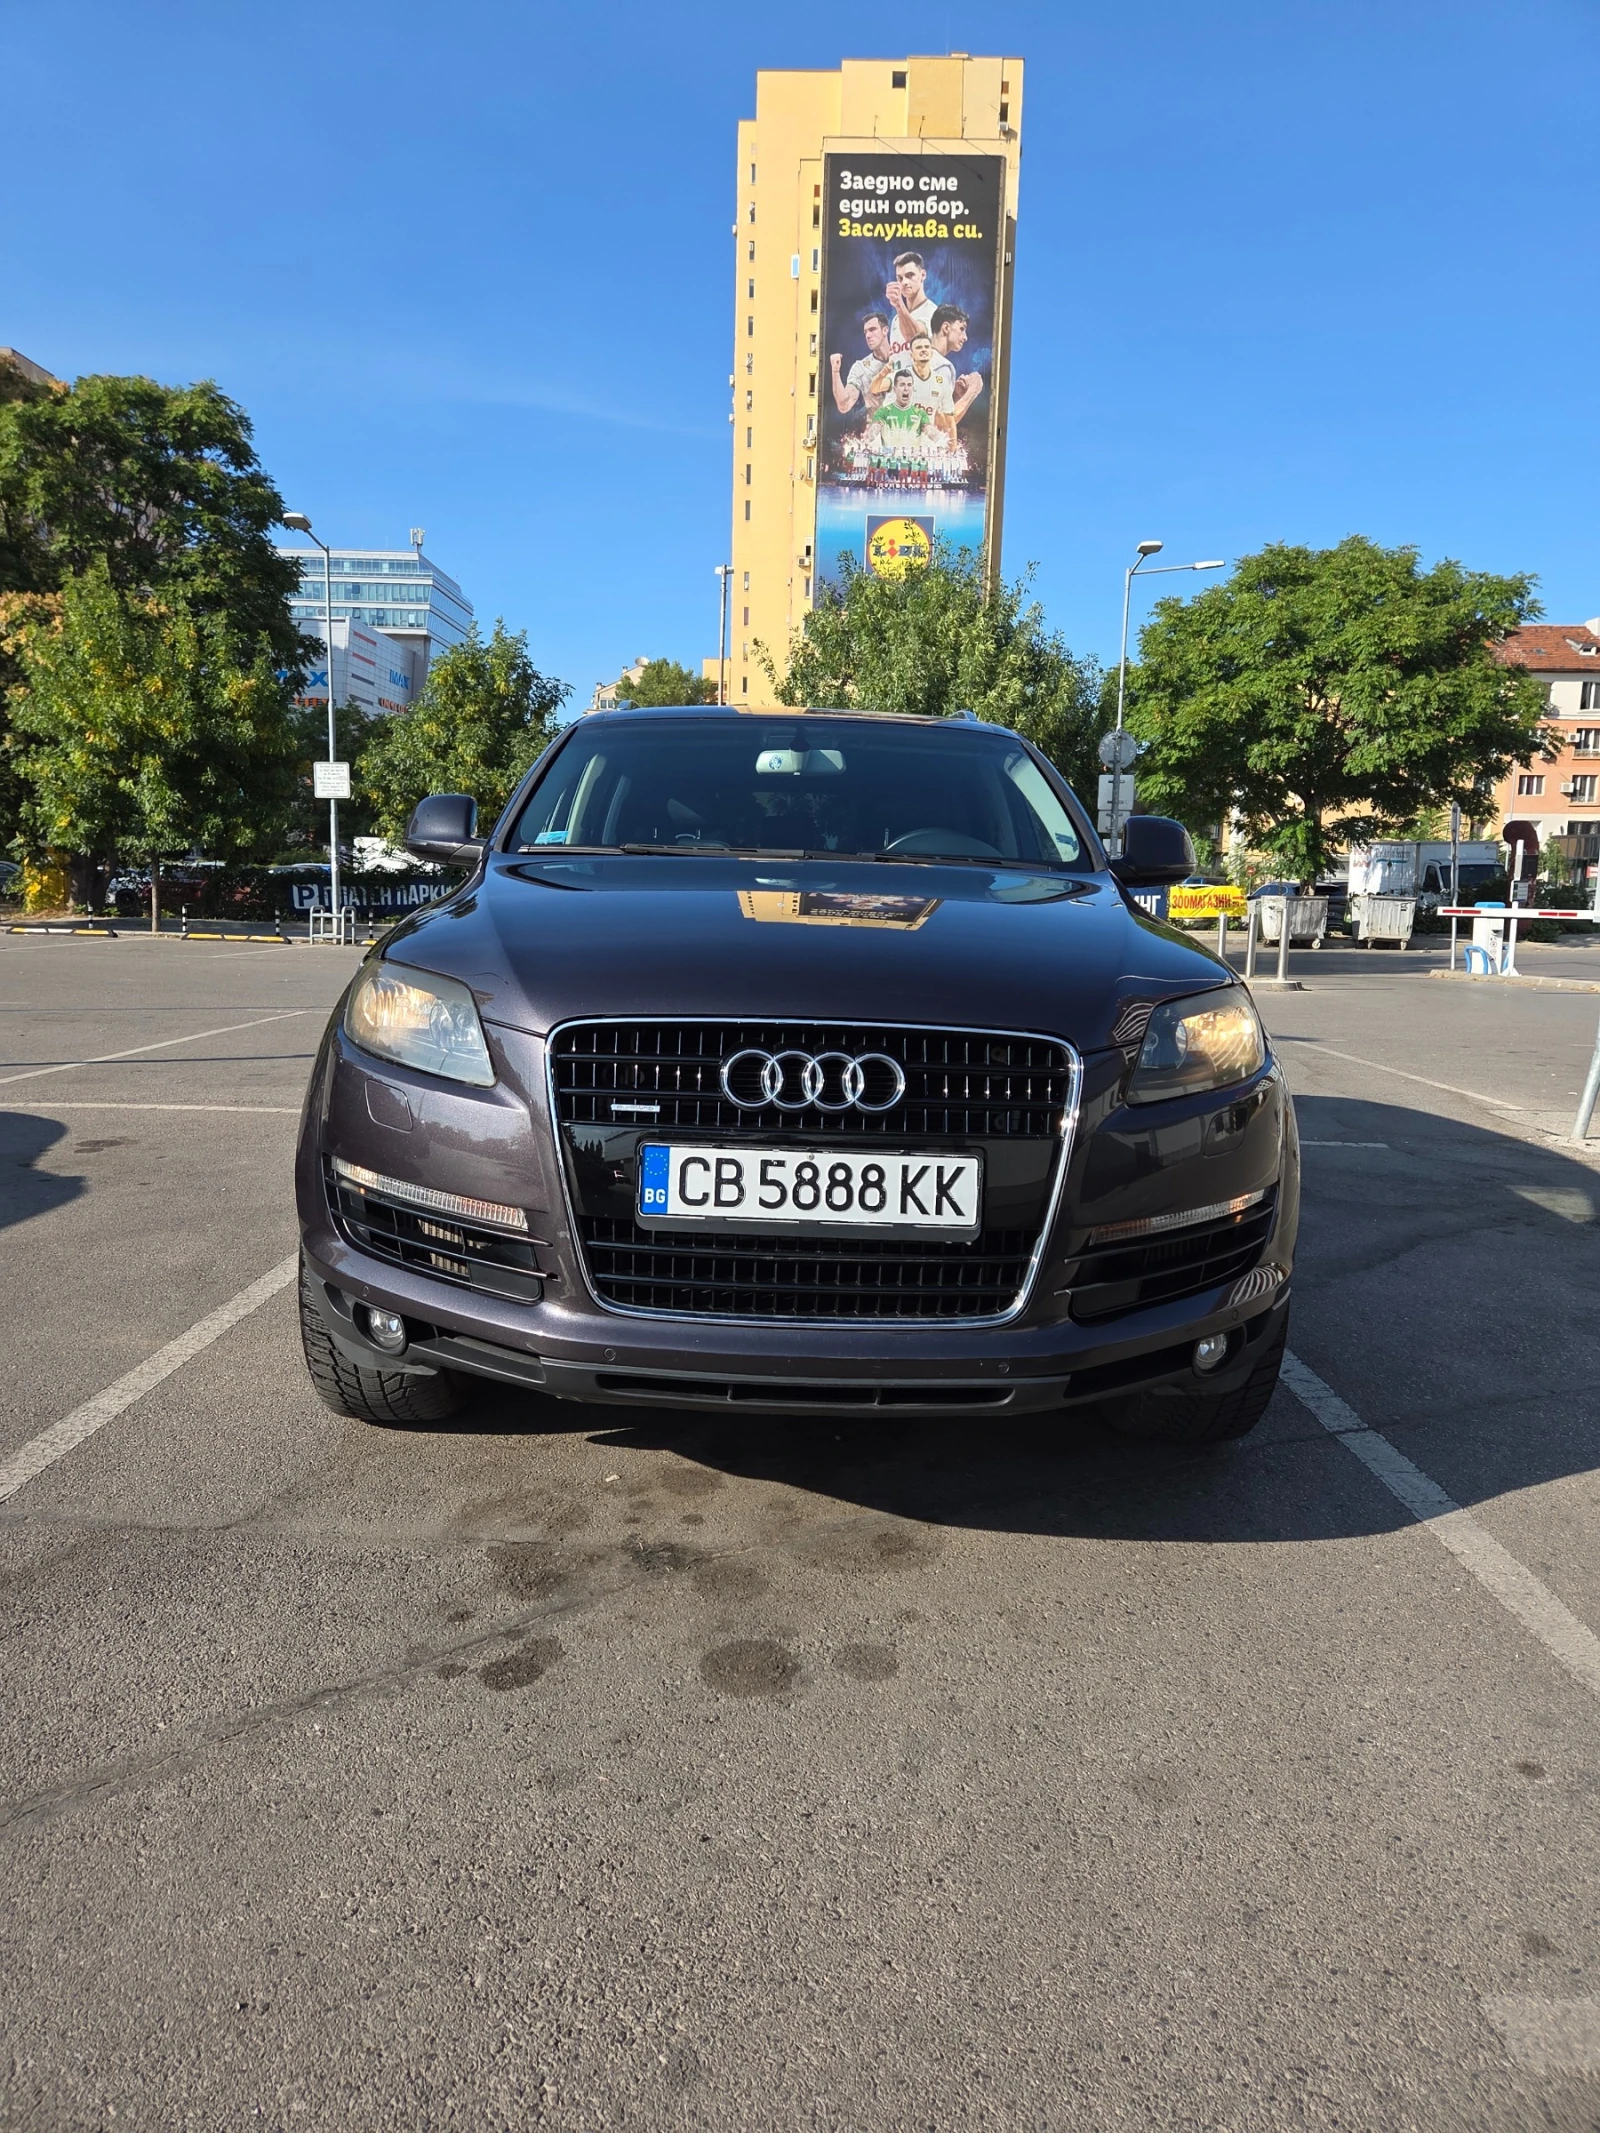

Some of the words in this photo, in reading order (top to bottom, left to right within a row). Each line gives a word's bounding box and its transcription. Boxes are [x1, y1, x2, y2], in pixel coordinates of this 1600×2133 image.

[840, 170, 914, 195] Заедно
[919, 176, 958, 191] сме
[839, 198, 890, 218] един
[895, 195, 969, 219] отбор.
[838, 218, 949, 242] Заслужава
[953, 223, 983, 239] си.
[1172, 893, 1231, 909] ЗООМАГАЗИН
[644, 1187, 666, 1204] BG
[758, 1158, 888, 1213] 5888
